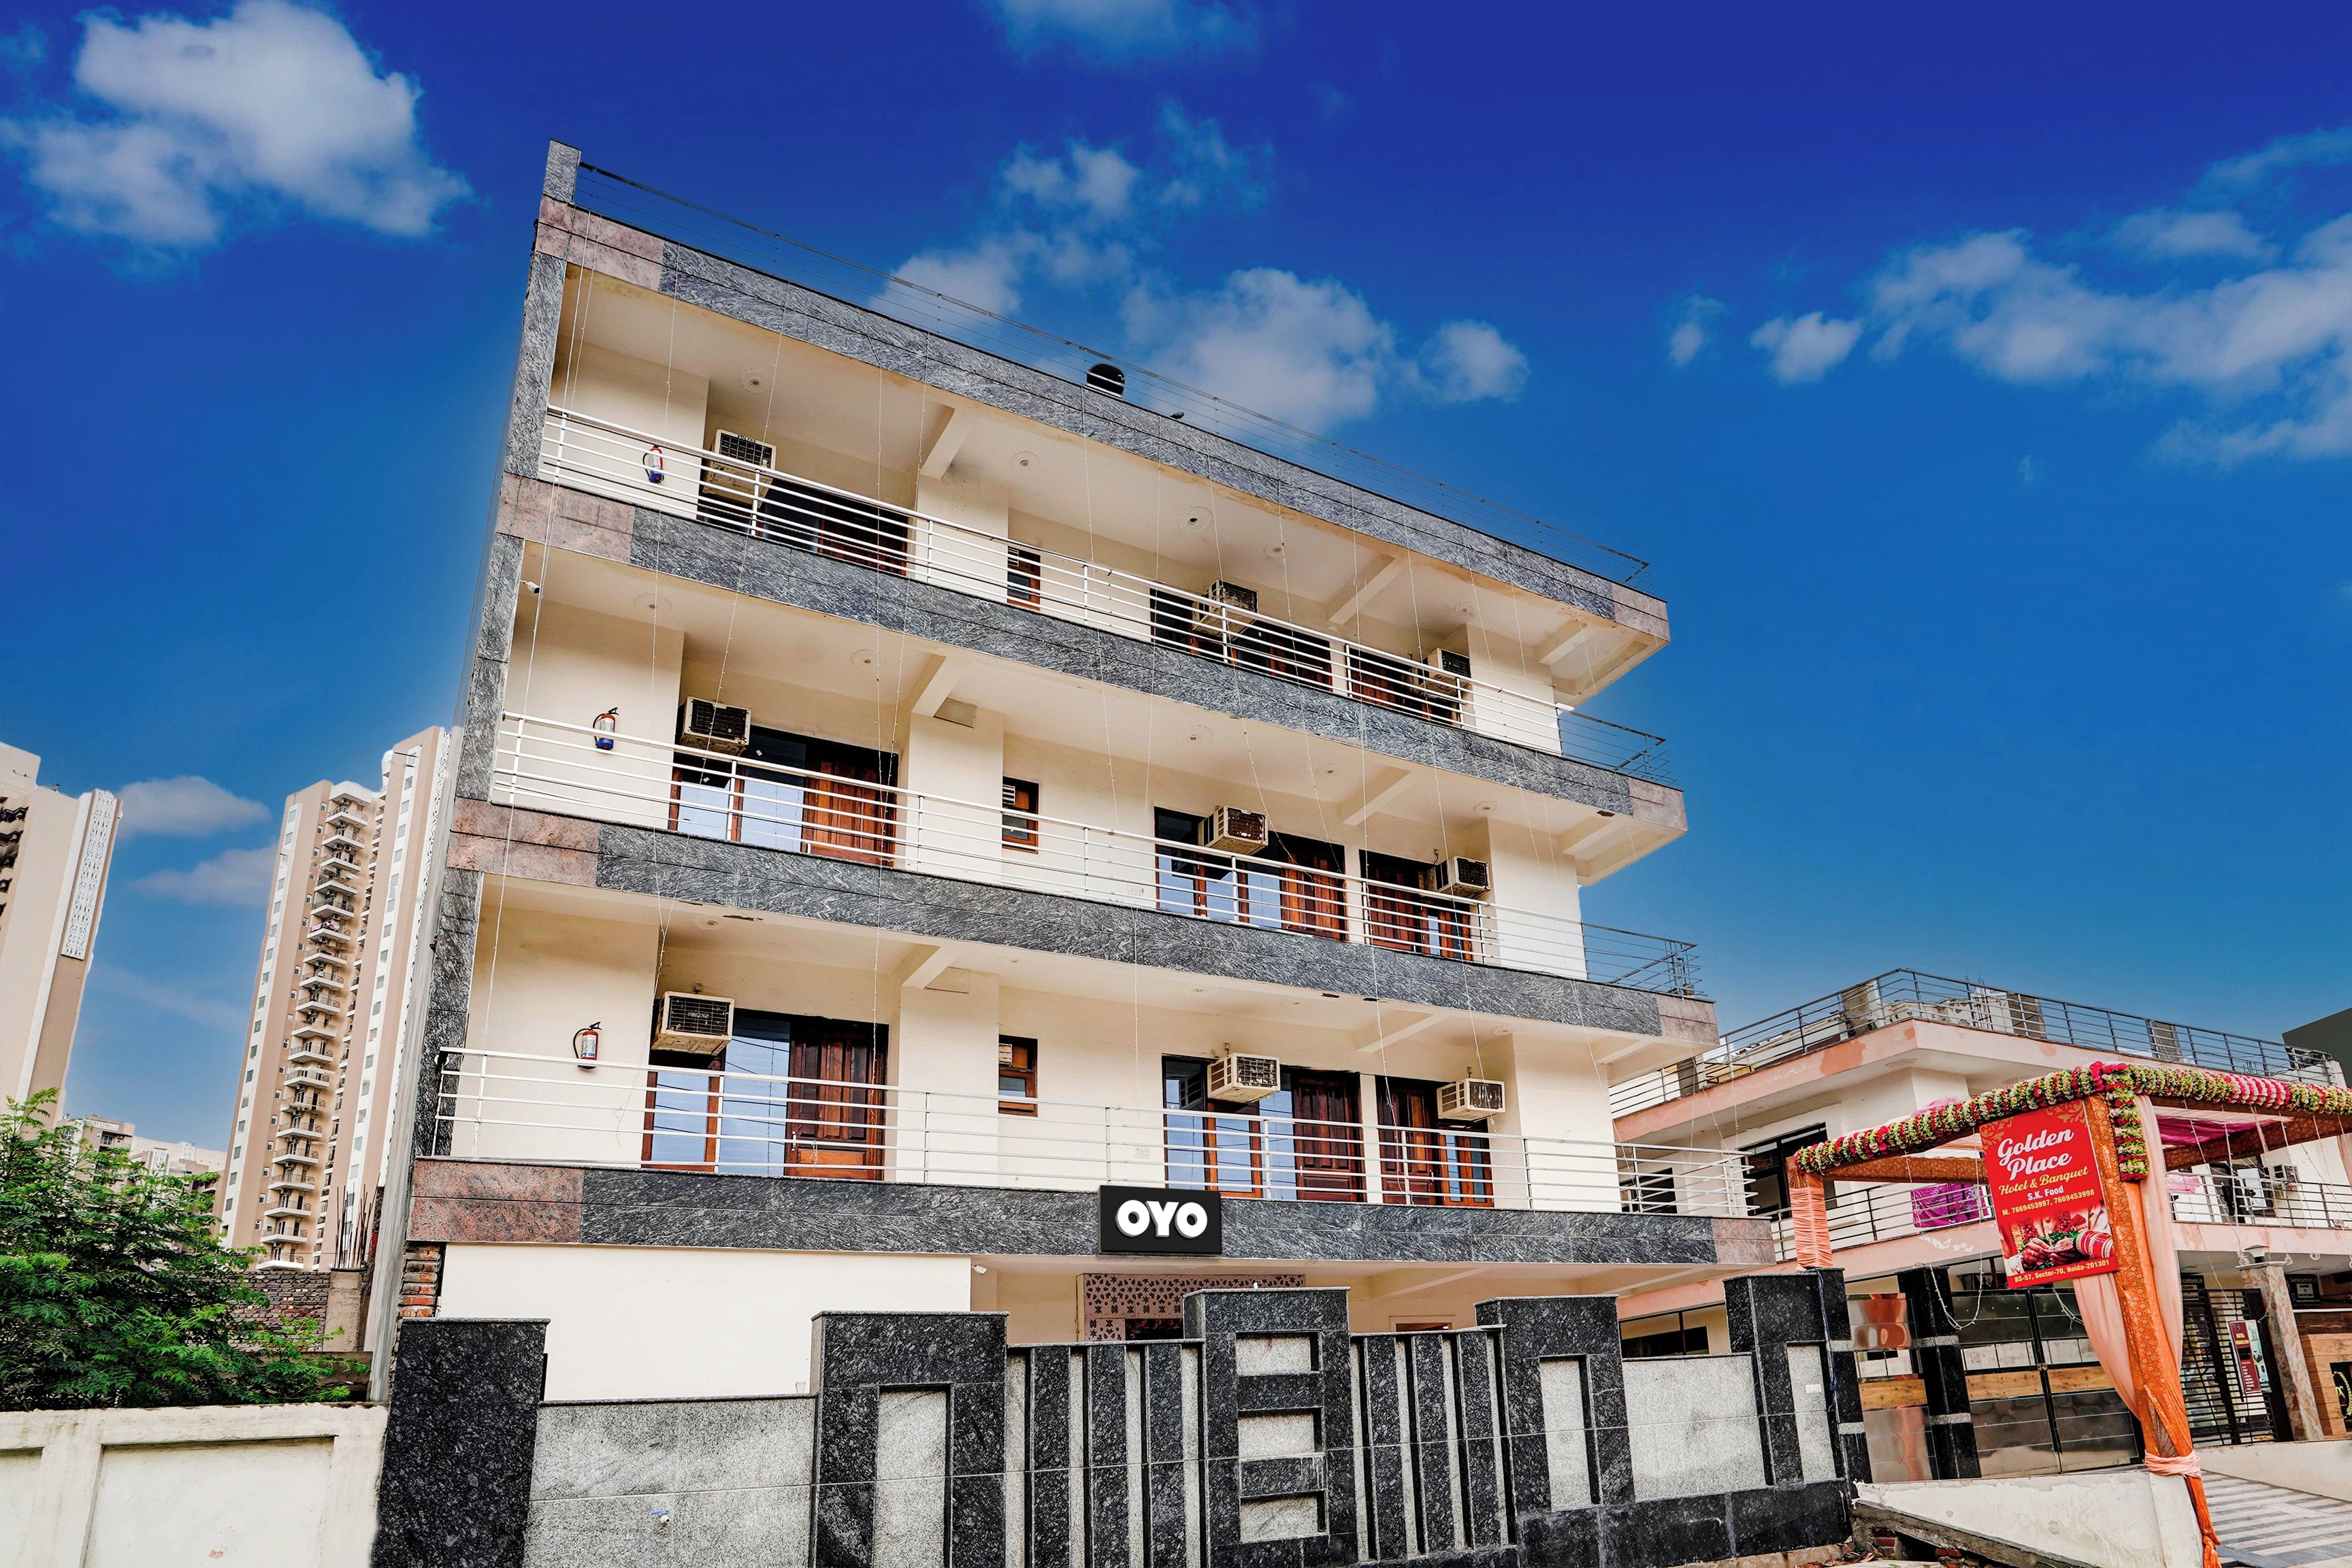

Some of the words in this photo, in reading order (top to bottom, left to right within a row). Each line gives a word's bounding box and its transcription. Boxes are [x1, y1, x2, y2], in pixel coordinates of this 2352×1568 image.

[1997, 1129, 2074, 1166] Golden
[1999, 1180, 2029, 1195] Hotel
[2029, 1178, 2038, 1188] &
[2040, 1166, 2089, 1186] Banquet
[2007, 1153, 2072, 1181] Place
[2011, 1200, 2053, 1213] 7669453997,
[2054, 1189, 2095, 1203] 7669453998
[2027, 1190, 2043, 1200] S.K.
[2044, 1186, 2064, 1196] Food
[1115, 1200, 1208, 1239] OYO
[2014, 1274, 2034, 1283] BS-57,
[2035, 1268, 2065, 1279] Sector-70,
[2067, 1260, 2110, 1273] Noida-201301
